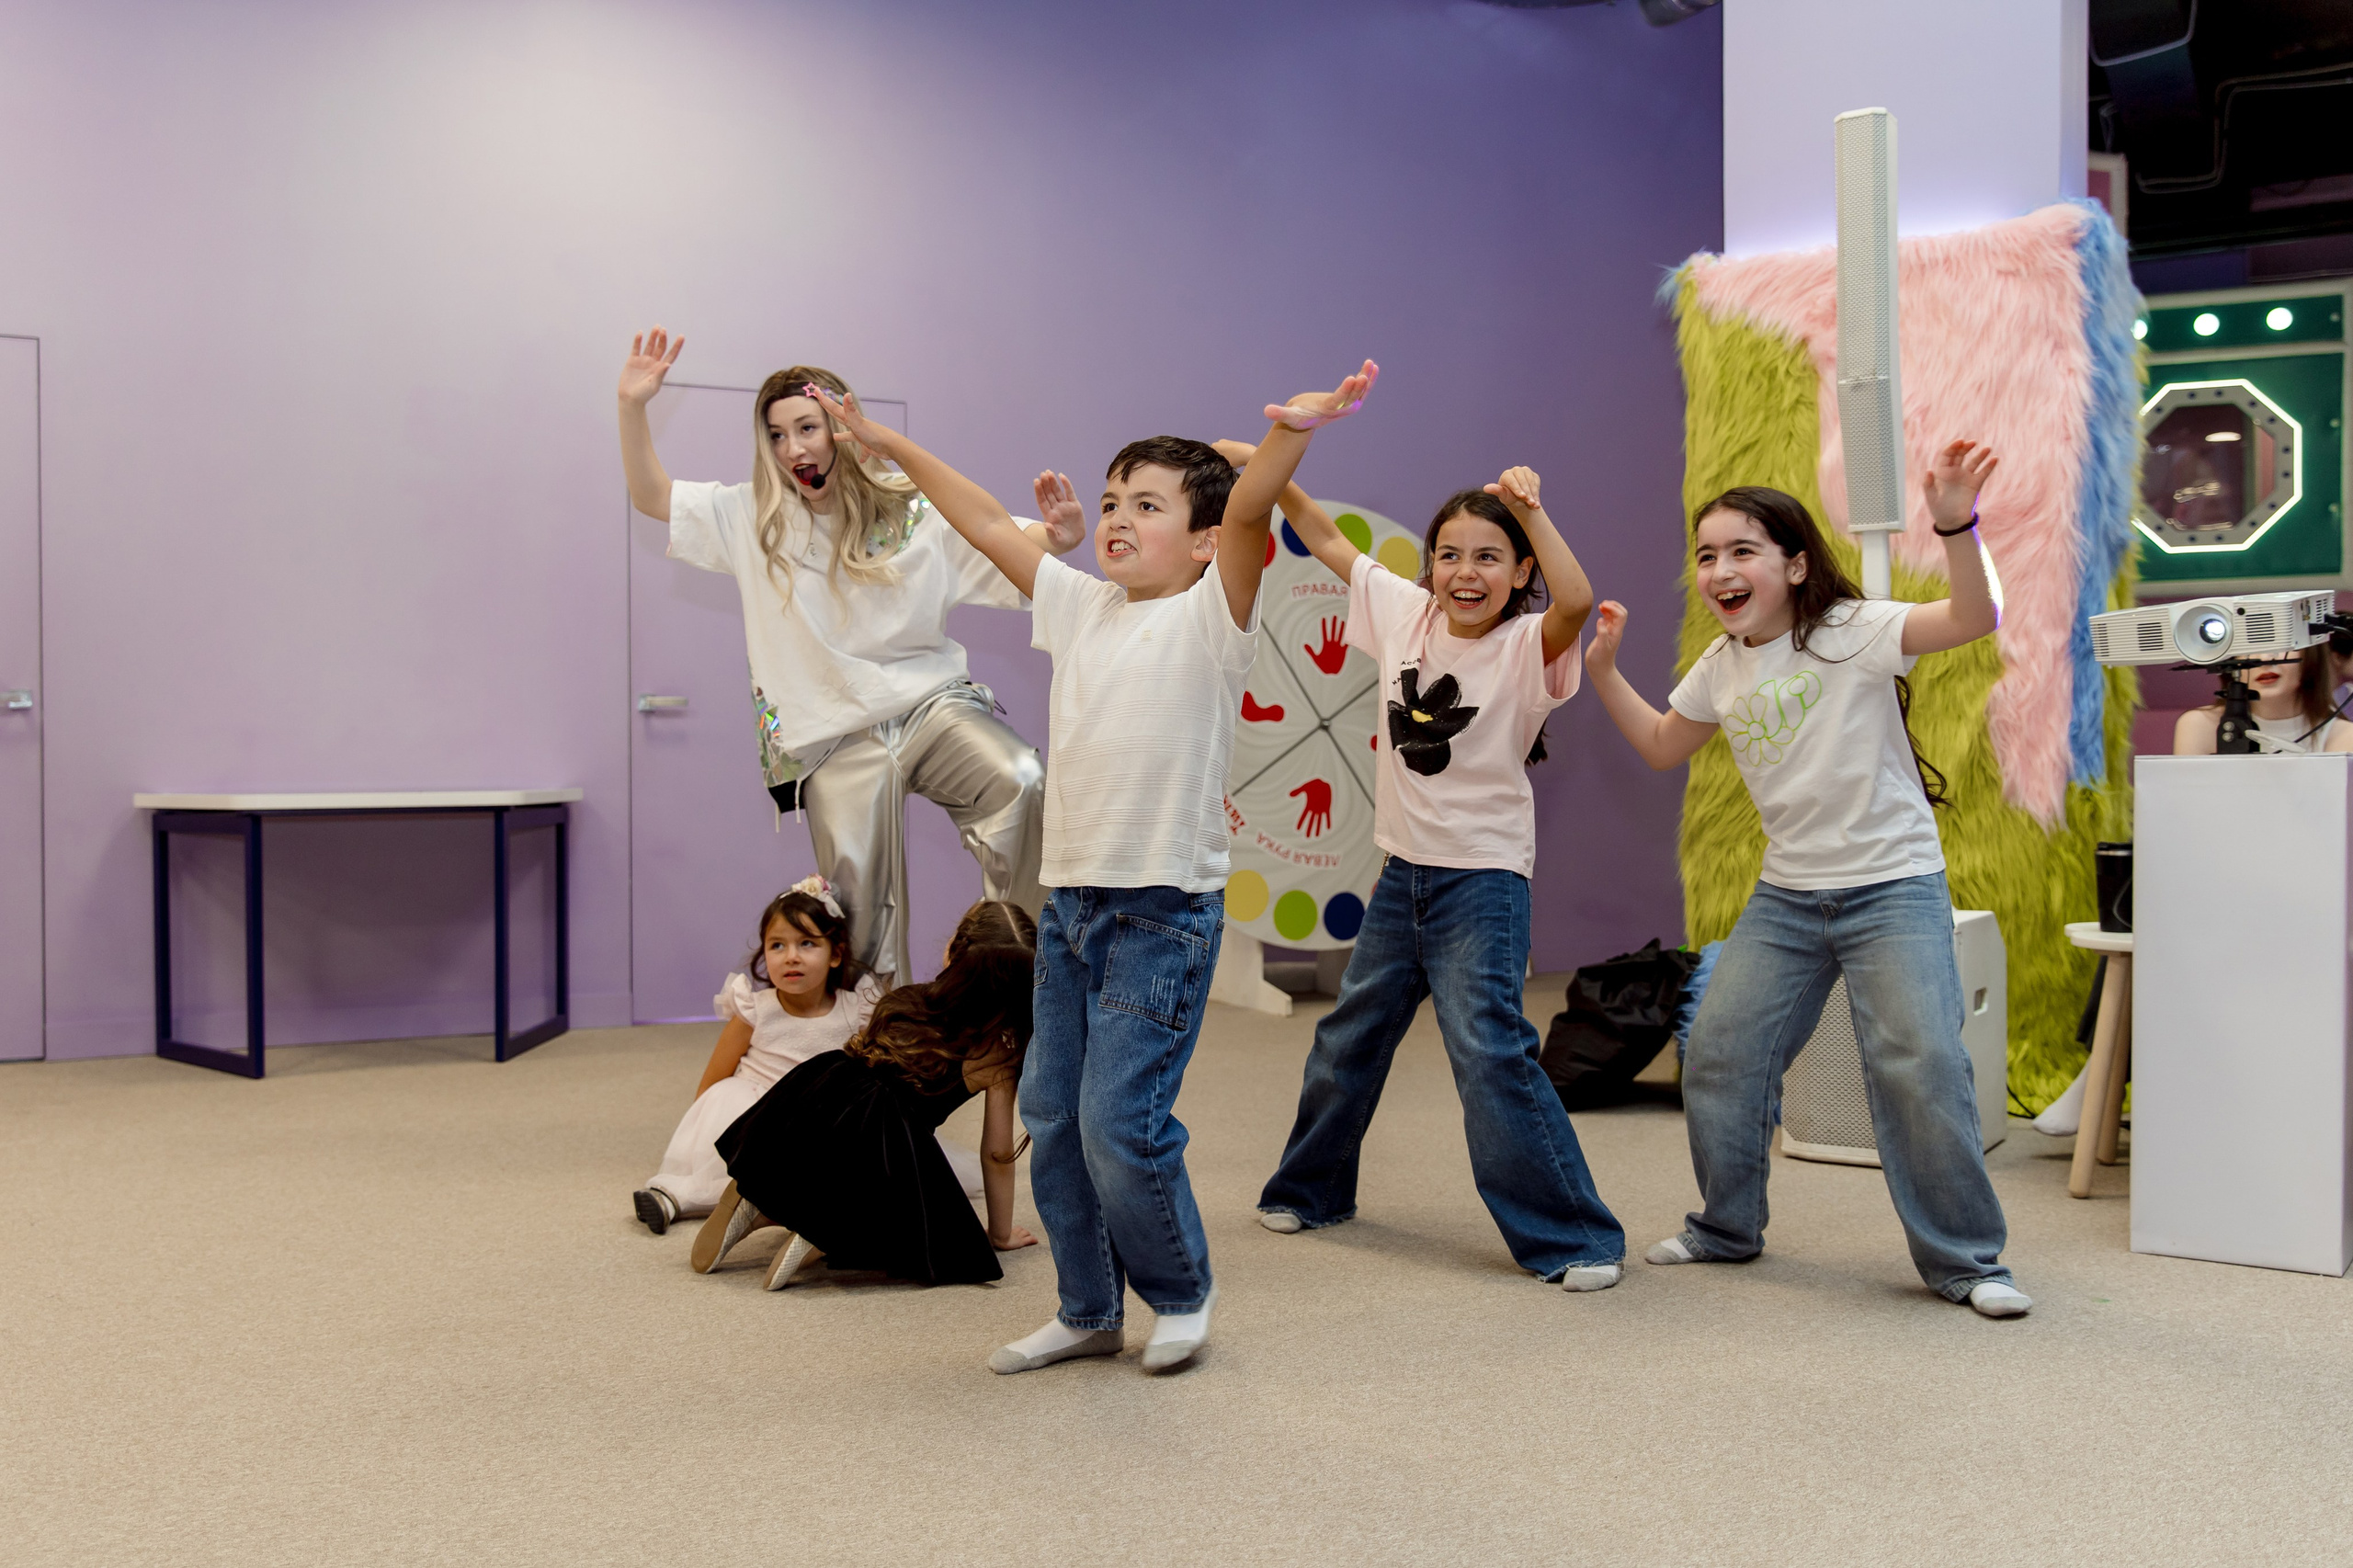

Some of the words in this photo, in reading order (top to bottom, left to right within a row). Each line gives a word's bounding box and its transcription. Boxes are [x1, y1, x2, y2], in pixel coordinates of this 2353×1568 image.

[1291, 584, 1347, 598] ПРАВАЯ
[1256, 832, 1291, 859] РУКА
[1292, 852, 1341, 867] ЛЕВАЯ
